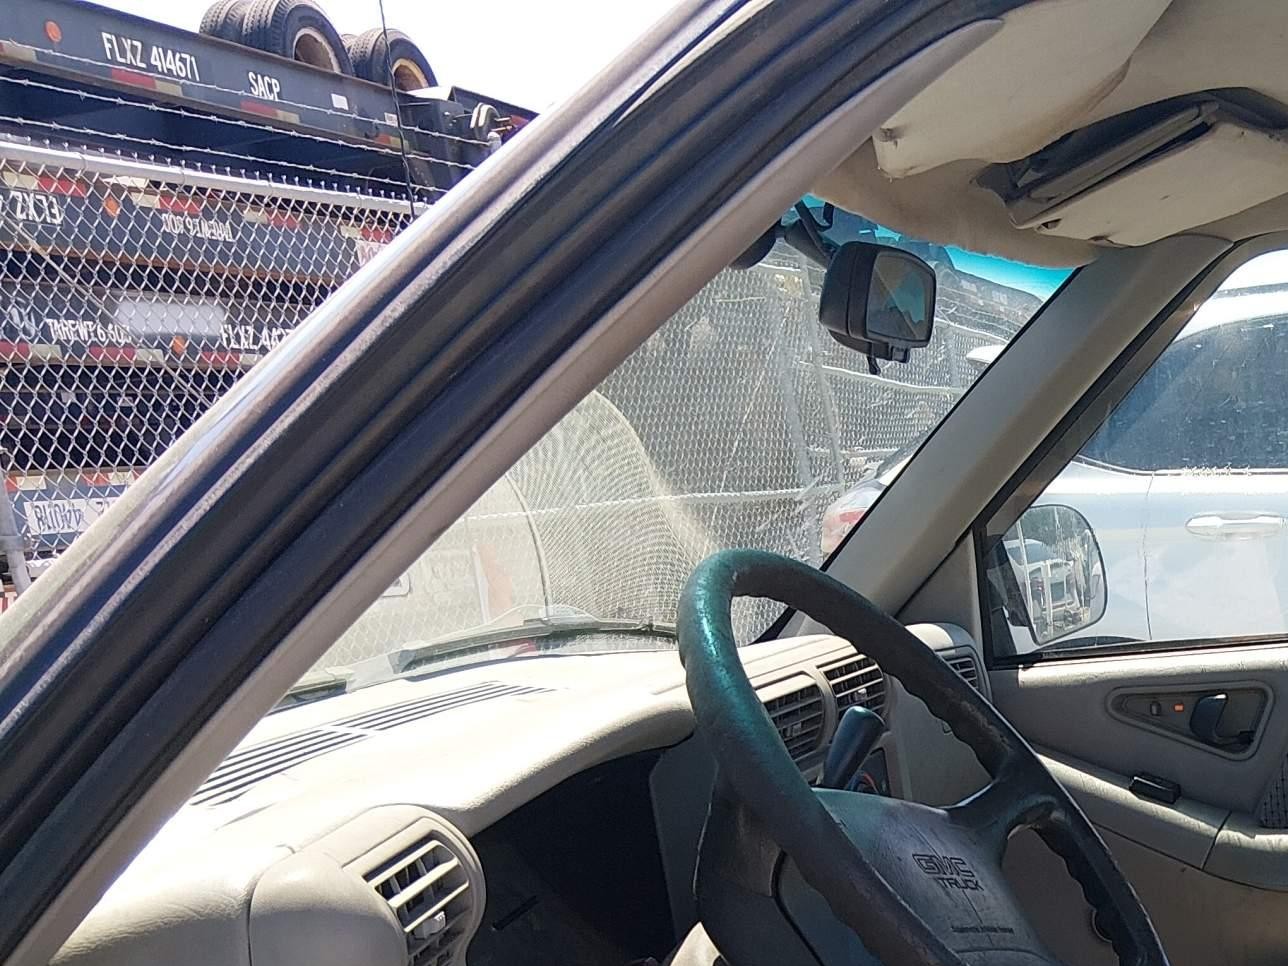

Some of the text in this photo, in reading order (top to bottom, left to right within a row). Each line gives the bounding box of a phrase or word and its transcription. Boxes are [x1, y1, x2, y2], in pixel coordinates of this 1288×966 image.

[102, 32, 200, 82] FLXZ 414671
[248, 71, 281, 101] SACP
[912, 853, 976, 878] GMC
[935, 877, 985, 892] TRUCK
